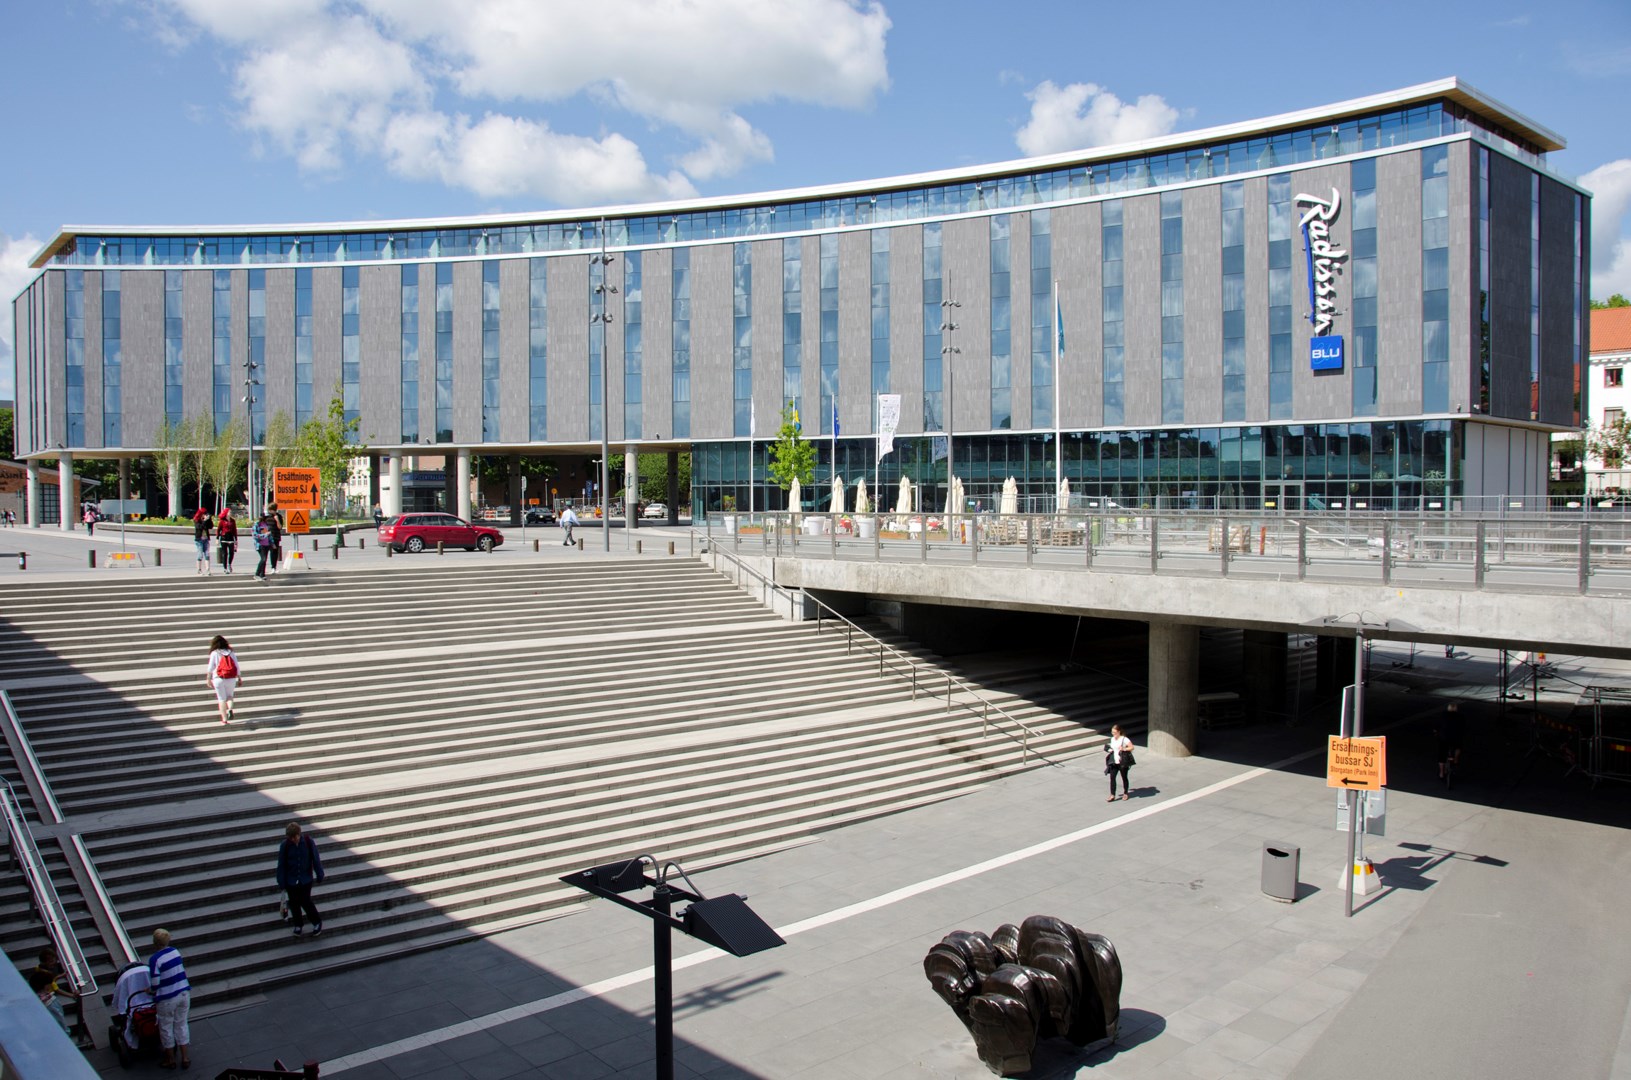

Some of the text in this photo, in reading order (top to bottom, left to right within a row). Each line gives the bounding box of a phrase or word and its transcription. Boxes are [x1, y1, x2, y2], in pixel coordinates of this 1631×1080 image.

[1294, 187, 1347, 334] Radisson
[1312, 347, 1340, 359] BLU
[277, 471, 315, 483] Ersättnings-
[277, 484, 308, 494] bussar SJ
[1331, 740, 1378, 757] Ersättnings-
[1335, 753, 1374, 768] bussar SJ
